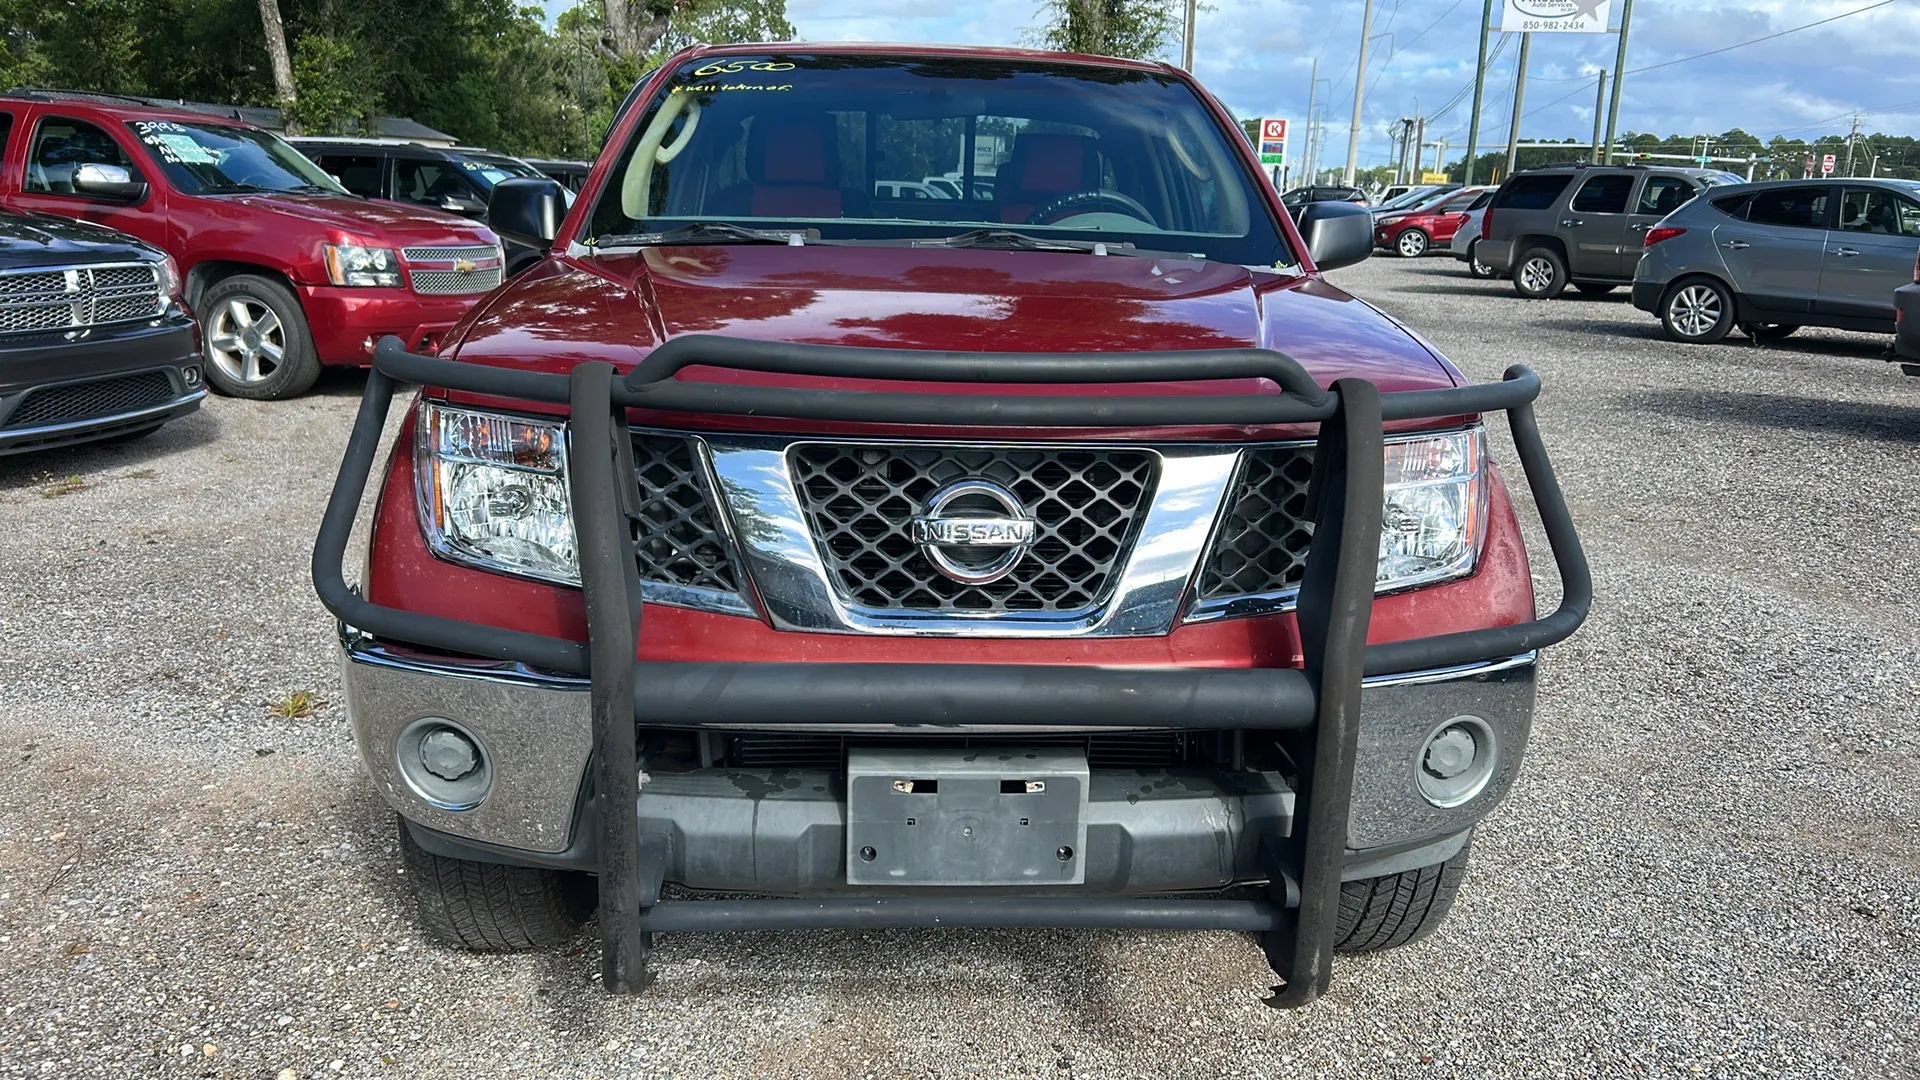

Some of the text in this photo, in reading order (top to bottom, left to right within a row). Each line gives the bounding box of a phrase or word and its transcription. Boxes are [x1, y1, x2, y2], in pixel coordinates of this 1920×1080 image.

[1522, 21, 1585, 30] 850-982-2434
[694, 60, 796, 76] 6500
[135, 121, 186, 134] 3995
[927, 524, 1024, 540] NISSAN
